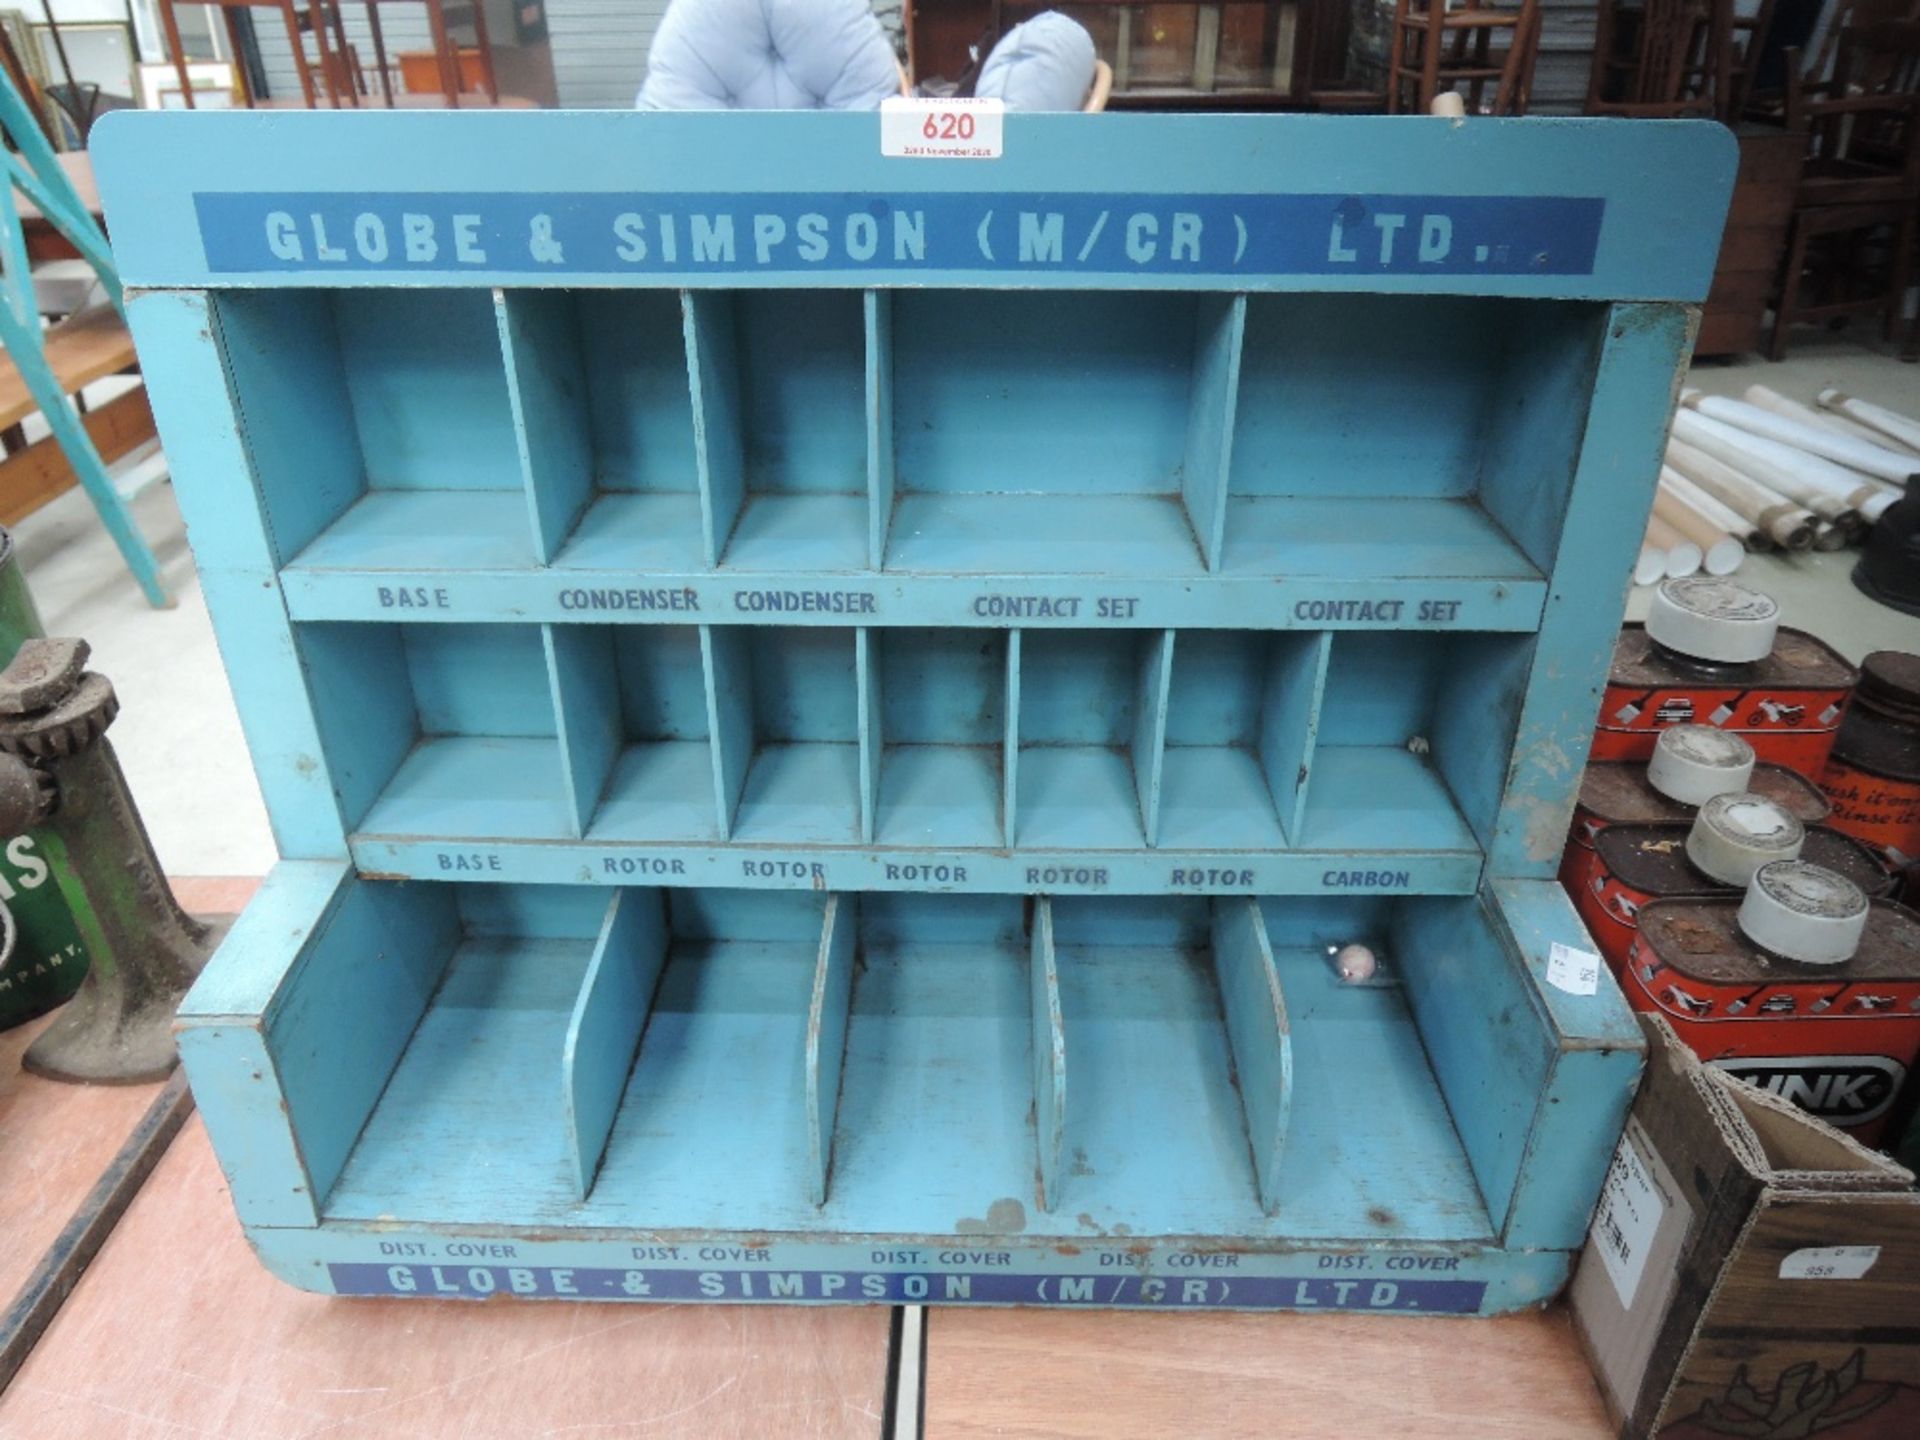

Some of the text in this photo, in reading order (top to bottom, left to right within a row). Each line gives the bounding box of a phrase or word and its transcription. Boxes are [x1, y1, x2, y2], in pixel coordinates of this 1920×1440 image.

[923, 112, 975, 139] 620
[265, 211, 487, 263] GLOBE
[530, 212, 566, 264] &
[613, 210, 926, 264] SIMPSON
[1328, 211, 1489, 264] LTD.
[378, 586, 451, 609] BASE
[558, 587, 700, 612] CONDENSER
[735, 590, 877, 614] CONDENSER
[974, 596, 1139, 618] CONTACT SET
[1294, 599, 1463, 622] CONTACT SET
[438, 854, 502, 872] BASE
[603, 857, 687, 876] ROTOR
[742, 860, 825, 879] ROTOR
[886, 864, 968, 883] ROTOR
[1025, 867, 1108, 885] ROTOR
[1171, 868, 1255, 887] ROTOR
[1321, 870, 1411, 888] CARBON
[379, 1241, 518, 1260] DIST. COVER
[632, 1246, 772, 1263] DIST. COVER
[871, 1250, 1012, 1267] DIST. COVER
[1100, 1253, 1240, 1270] DIST. COVER
[1318, 1254, 1461, 1271] DIST. COVER
[387, 1265, 579, 1294] GLOBE
[621, 1270, 652, 1296] &
[699, 1272, 972, 1298] SIMPSON
[1295, 1280, 1420, 1307] LTD.
